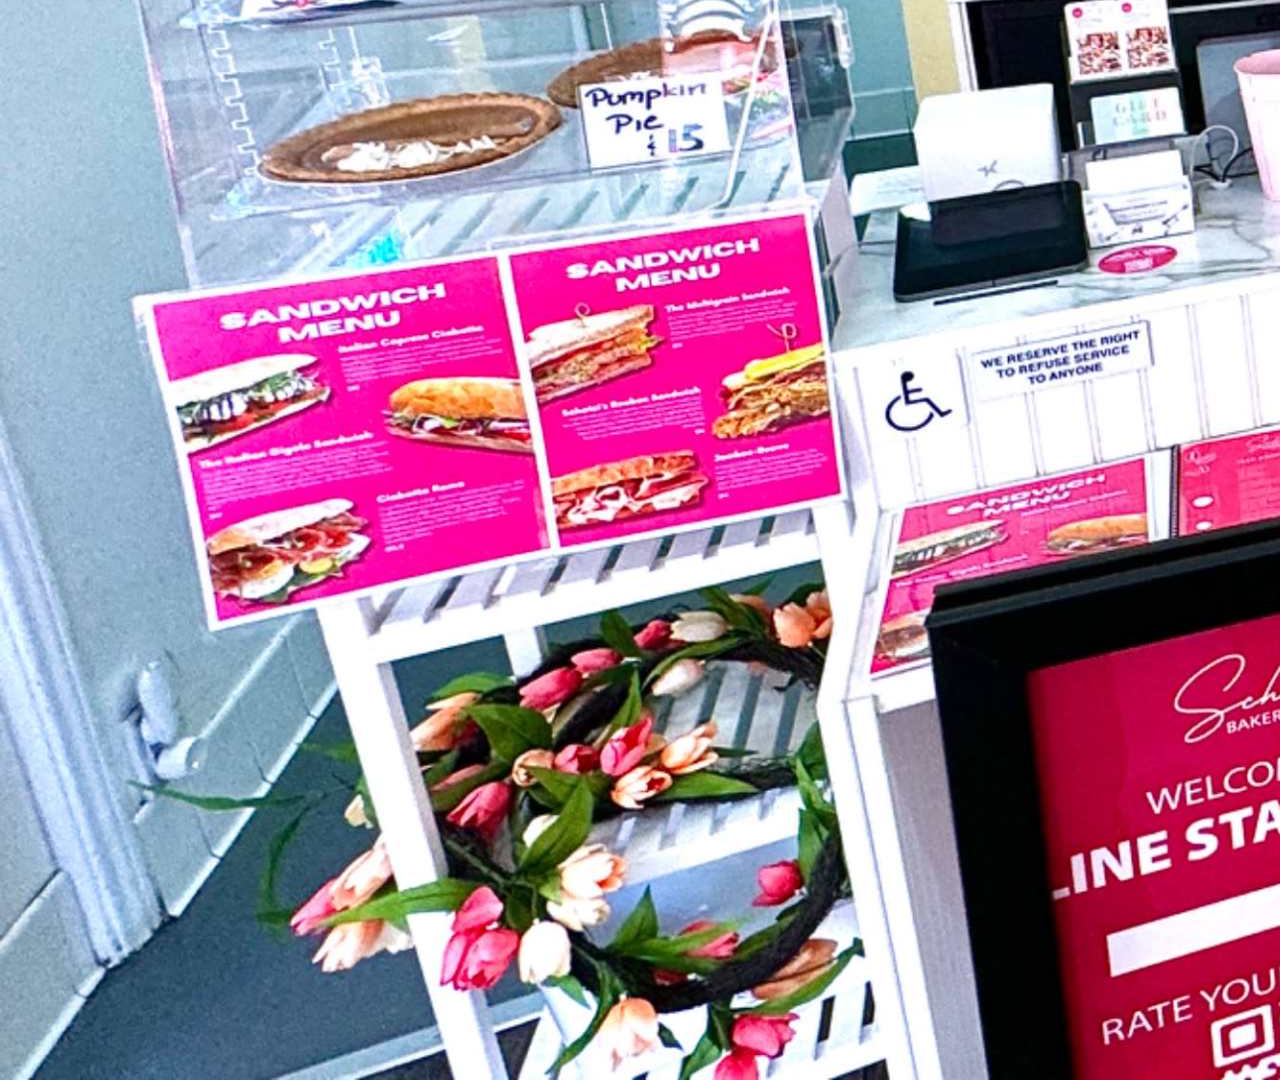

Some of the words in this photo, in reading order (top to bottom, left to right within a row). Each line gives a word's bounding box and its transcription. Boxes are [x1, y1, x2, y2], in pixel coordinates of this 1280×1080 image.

[585, 83, 708, 110] Pumpkin
[606, 113, 664, 134] Pie
[566, 237, 760, 280] SANDWICH
[616, 262, 721, 293] MENU
[219, 282, 447, 332] SANDWICH
[278, 310, 401, 344] MENU
[980, 357, 1003, 369] WE
[1007, 344, 1069, 365] RESERVE
[1071, 338, 1097, 351] THE
[1100, 330, 1140, 345] RIGHT
[996, 368, 1016, 379] TO
[1018, 356, 1070, 375] REFUSE
[1074, 345, 1130, 362] SERVICE
[1028, 373, 1046, 385] TO
[1049, 363, 1103, 381] ANYONE
[947, 473, 1106, 516] SANDWICH
[983, 491, 1072, 518] MENU
[1052, 831, 1173, 901] INE
[1101, 994, 1194, 1047] RATE
